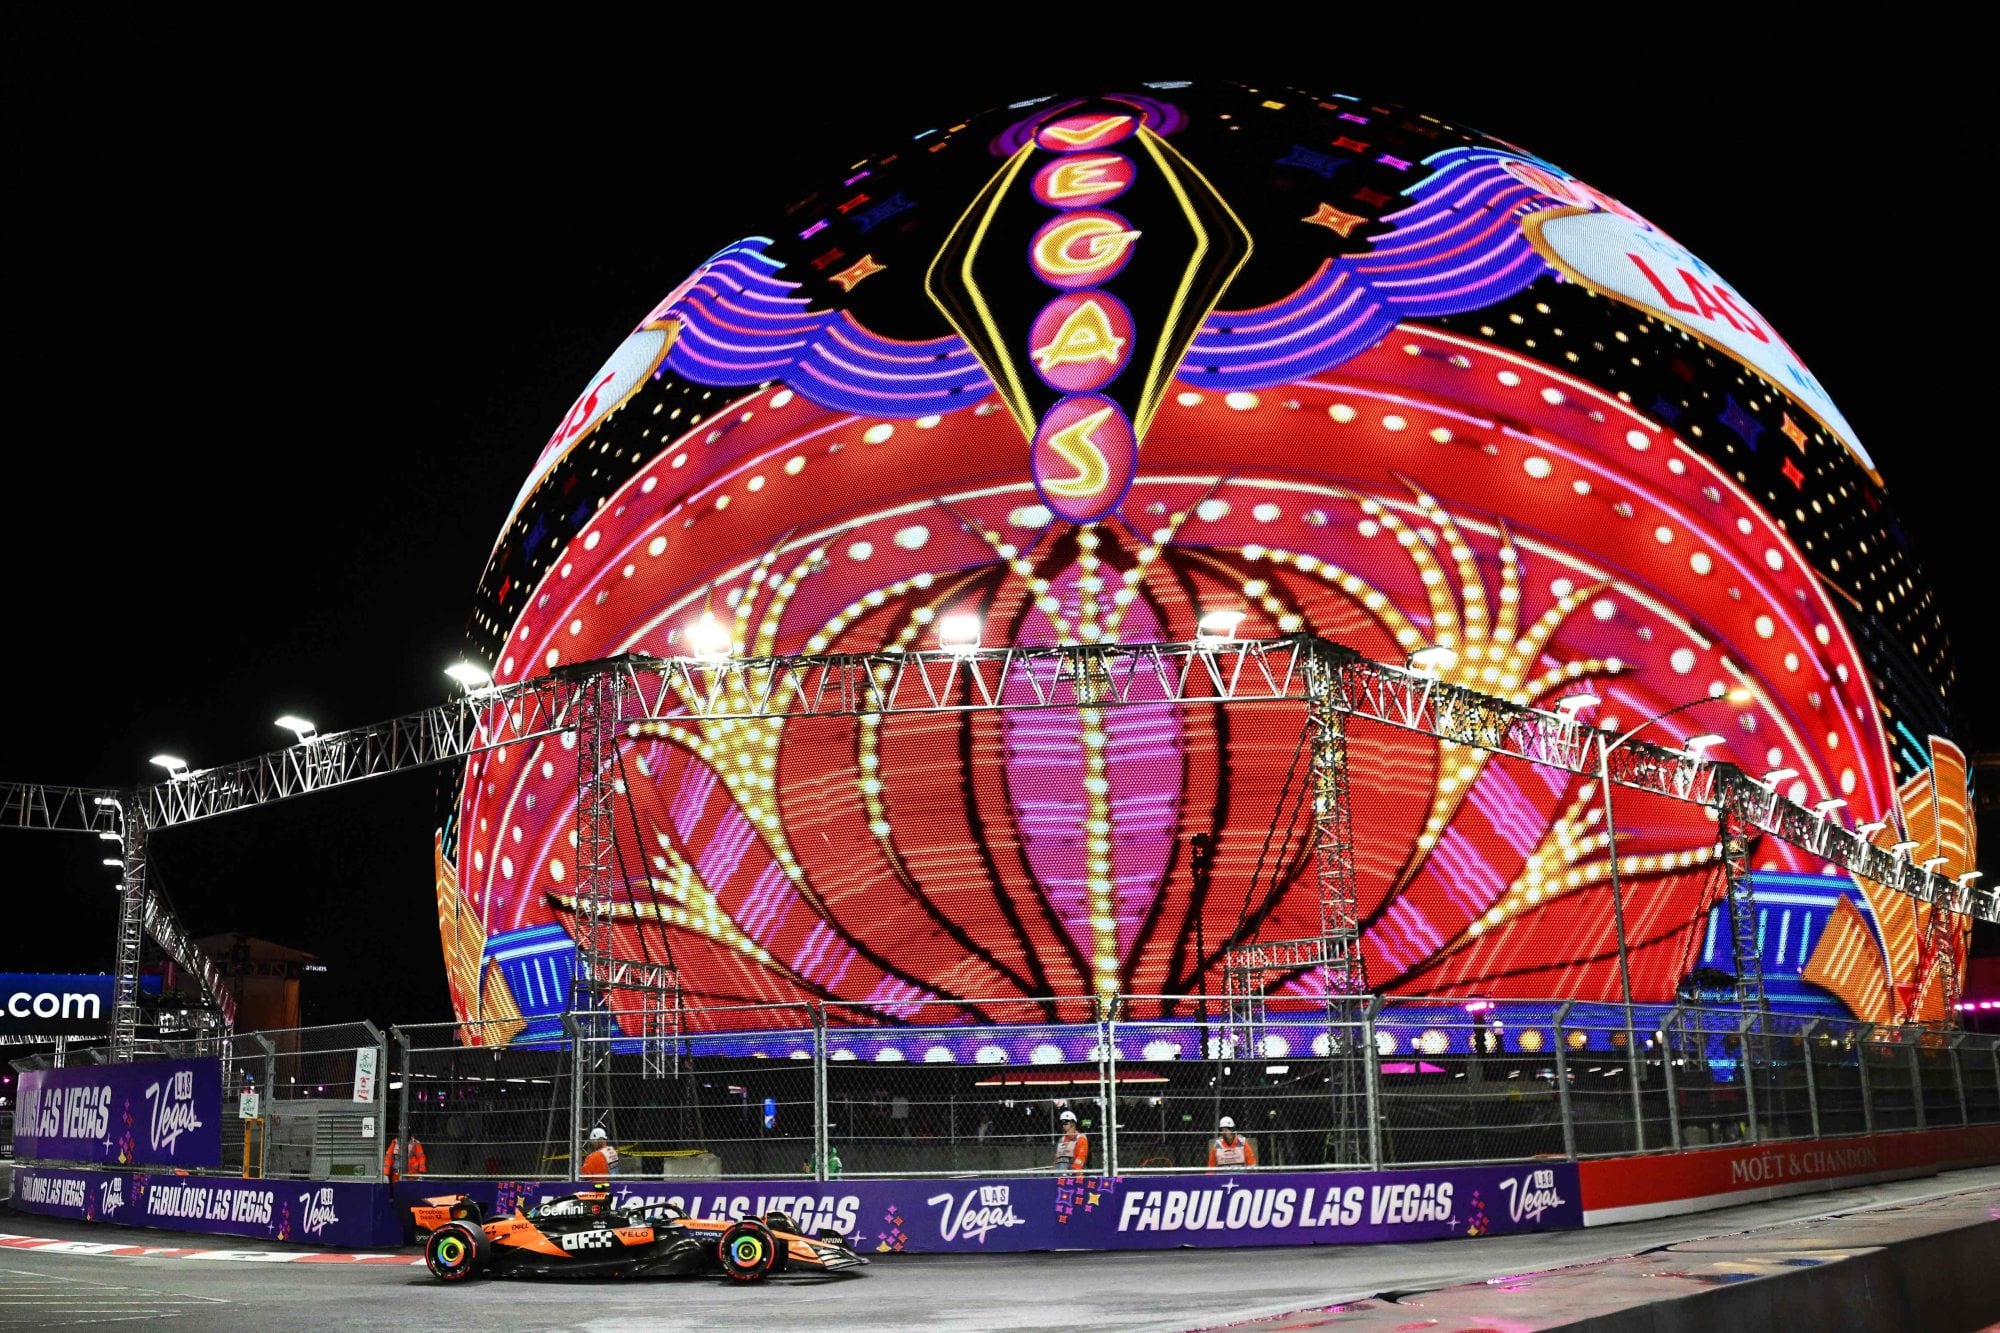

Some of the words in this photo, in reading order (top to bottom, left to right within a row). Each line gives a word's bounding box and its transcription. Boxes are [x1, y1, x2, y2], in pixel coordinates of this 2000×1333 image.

[1033, 115, 1142, 497] VEGAS
[1626, 252, 1771, 344] LAS
[0, 992, 100, 1019] .com
[176, 1073, 192, 1098] LAS
[36, 1088, 61, 1138] LAS
[62, 1085, 111, 1138] VEGAS
[146, 1077, 202, 1155] Vegas
[1731, 1151, 1785, 1184] MOËT
[1789, 1155, 1801, 1175] &
[1803, 1147, 1879, 1173] CHANDON
[46, 1178, 60, 1205] LAS
[60, 1179, 86, 1207] VEGAS
[147, 1185, 206, 1217] FABULOUS
[205, 1188, 231, 1221] LAS
[231, 1189, 274, 1224] VEGAS
[540, 1203, 584, 1217] Gemini
[982, 1187, 1008, 1205] LAS
[1117, 1187, 1297, 1231] FABULOUS
[1299, 1186, 1365, 1227] LAS
[1370, 1182, 1454, 1224] VEGAS
[1500, 1174, 1565, 1223] Vegas
[300, 1190, 338, 1236] Vegas
[511, 1223, 529, 1231] DELL
[756, 1196, 860, 1236] VEGAS
[927, 1189, 1026, 1244] Vegas
